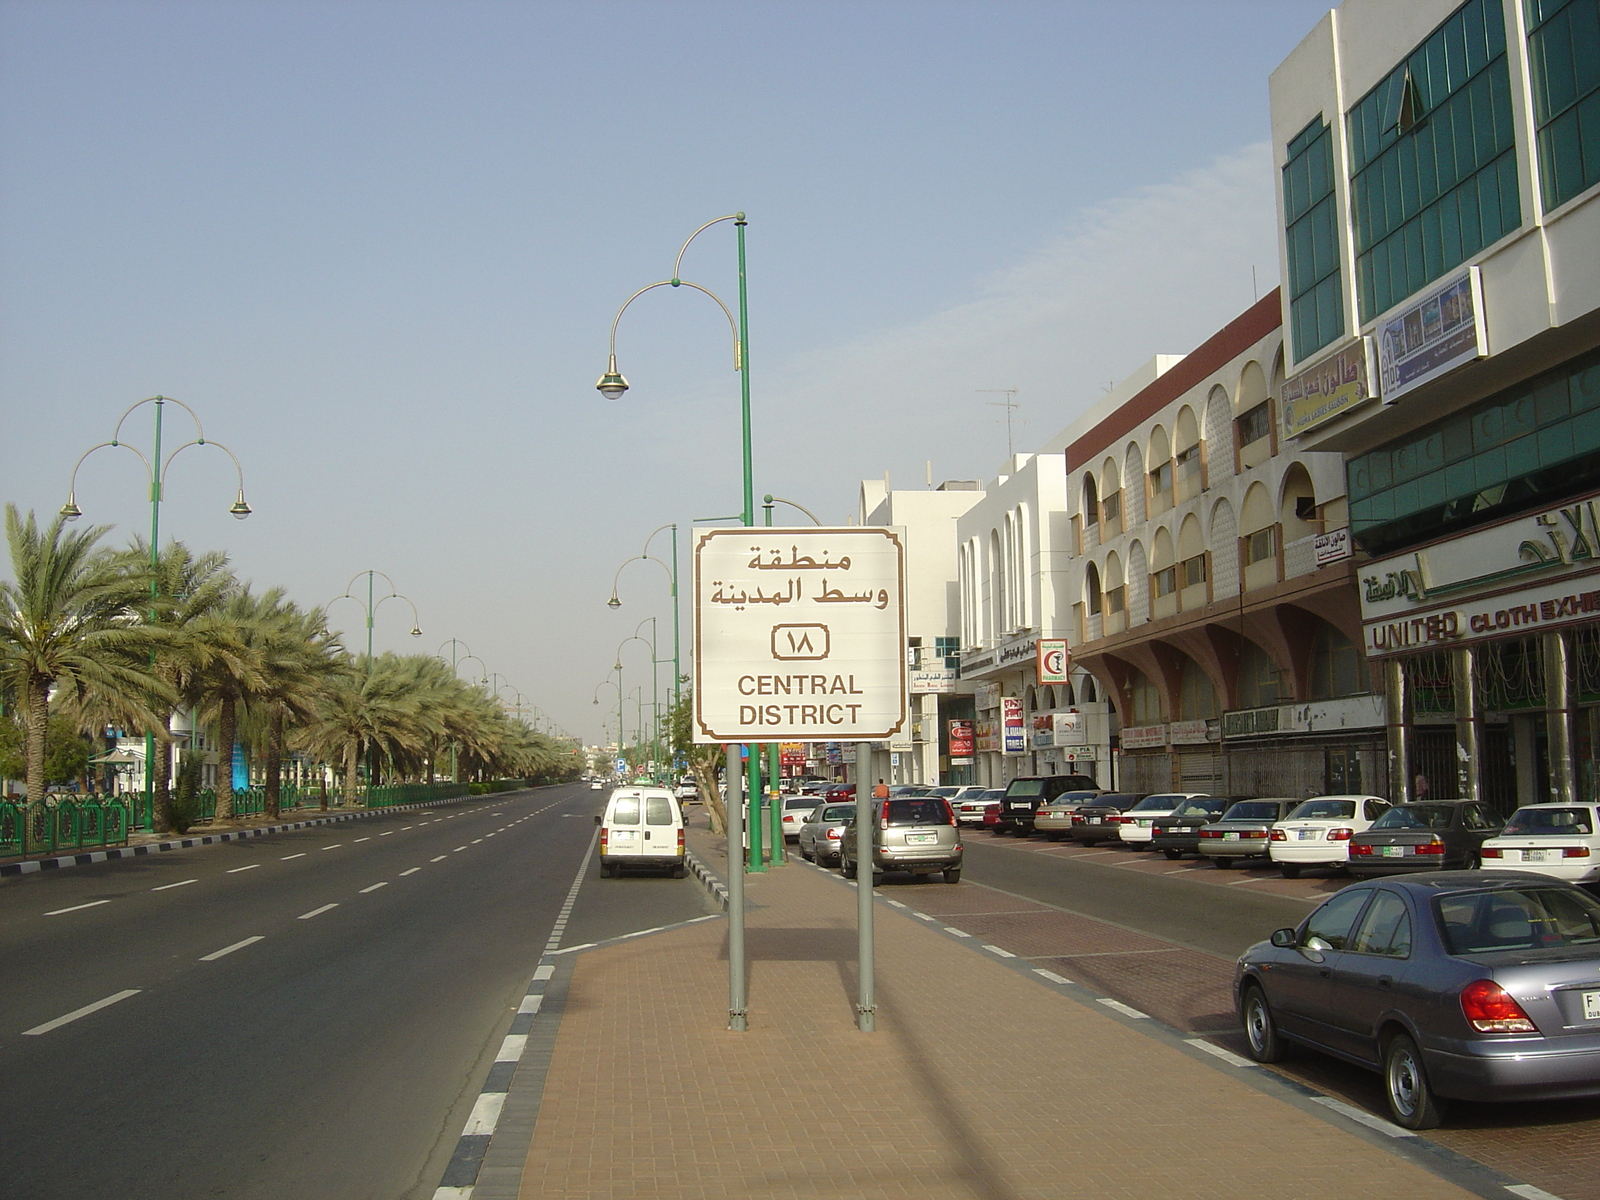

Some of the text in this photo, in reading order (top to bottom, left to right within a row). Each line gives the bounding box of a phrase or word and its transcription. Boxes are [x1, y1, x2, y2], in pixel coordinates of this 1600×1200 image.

[747, 545, 852, 571] منطقة
[710, 576, 889, 611] وسط المدينة
[1372, 611, 1464, 650] UNITED
[1470, 603, 1538, 634] CLOTH
[737, 674, 864, 696] CENTRAL
[739, 704, 863, 725] DISTRICT
[1585, 994, 1593, 1008] F
